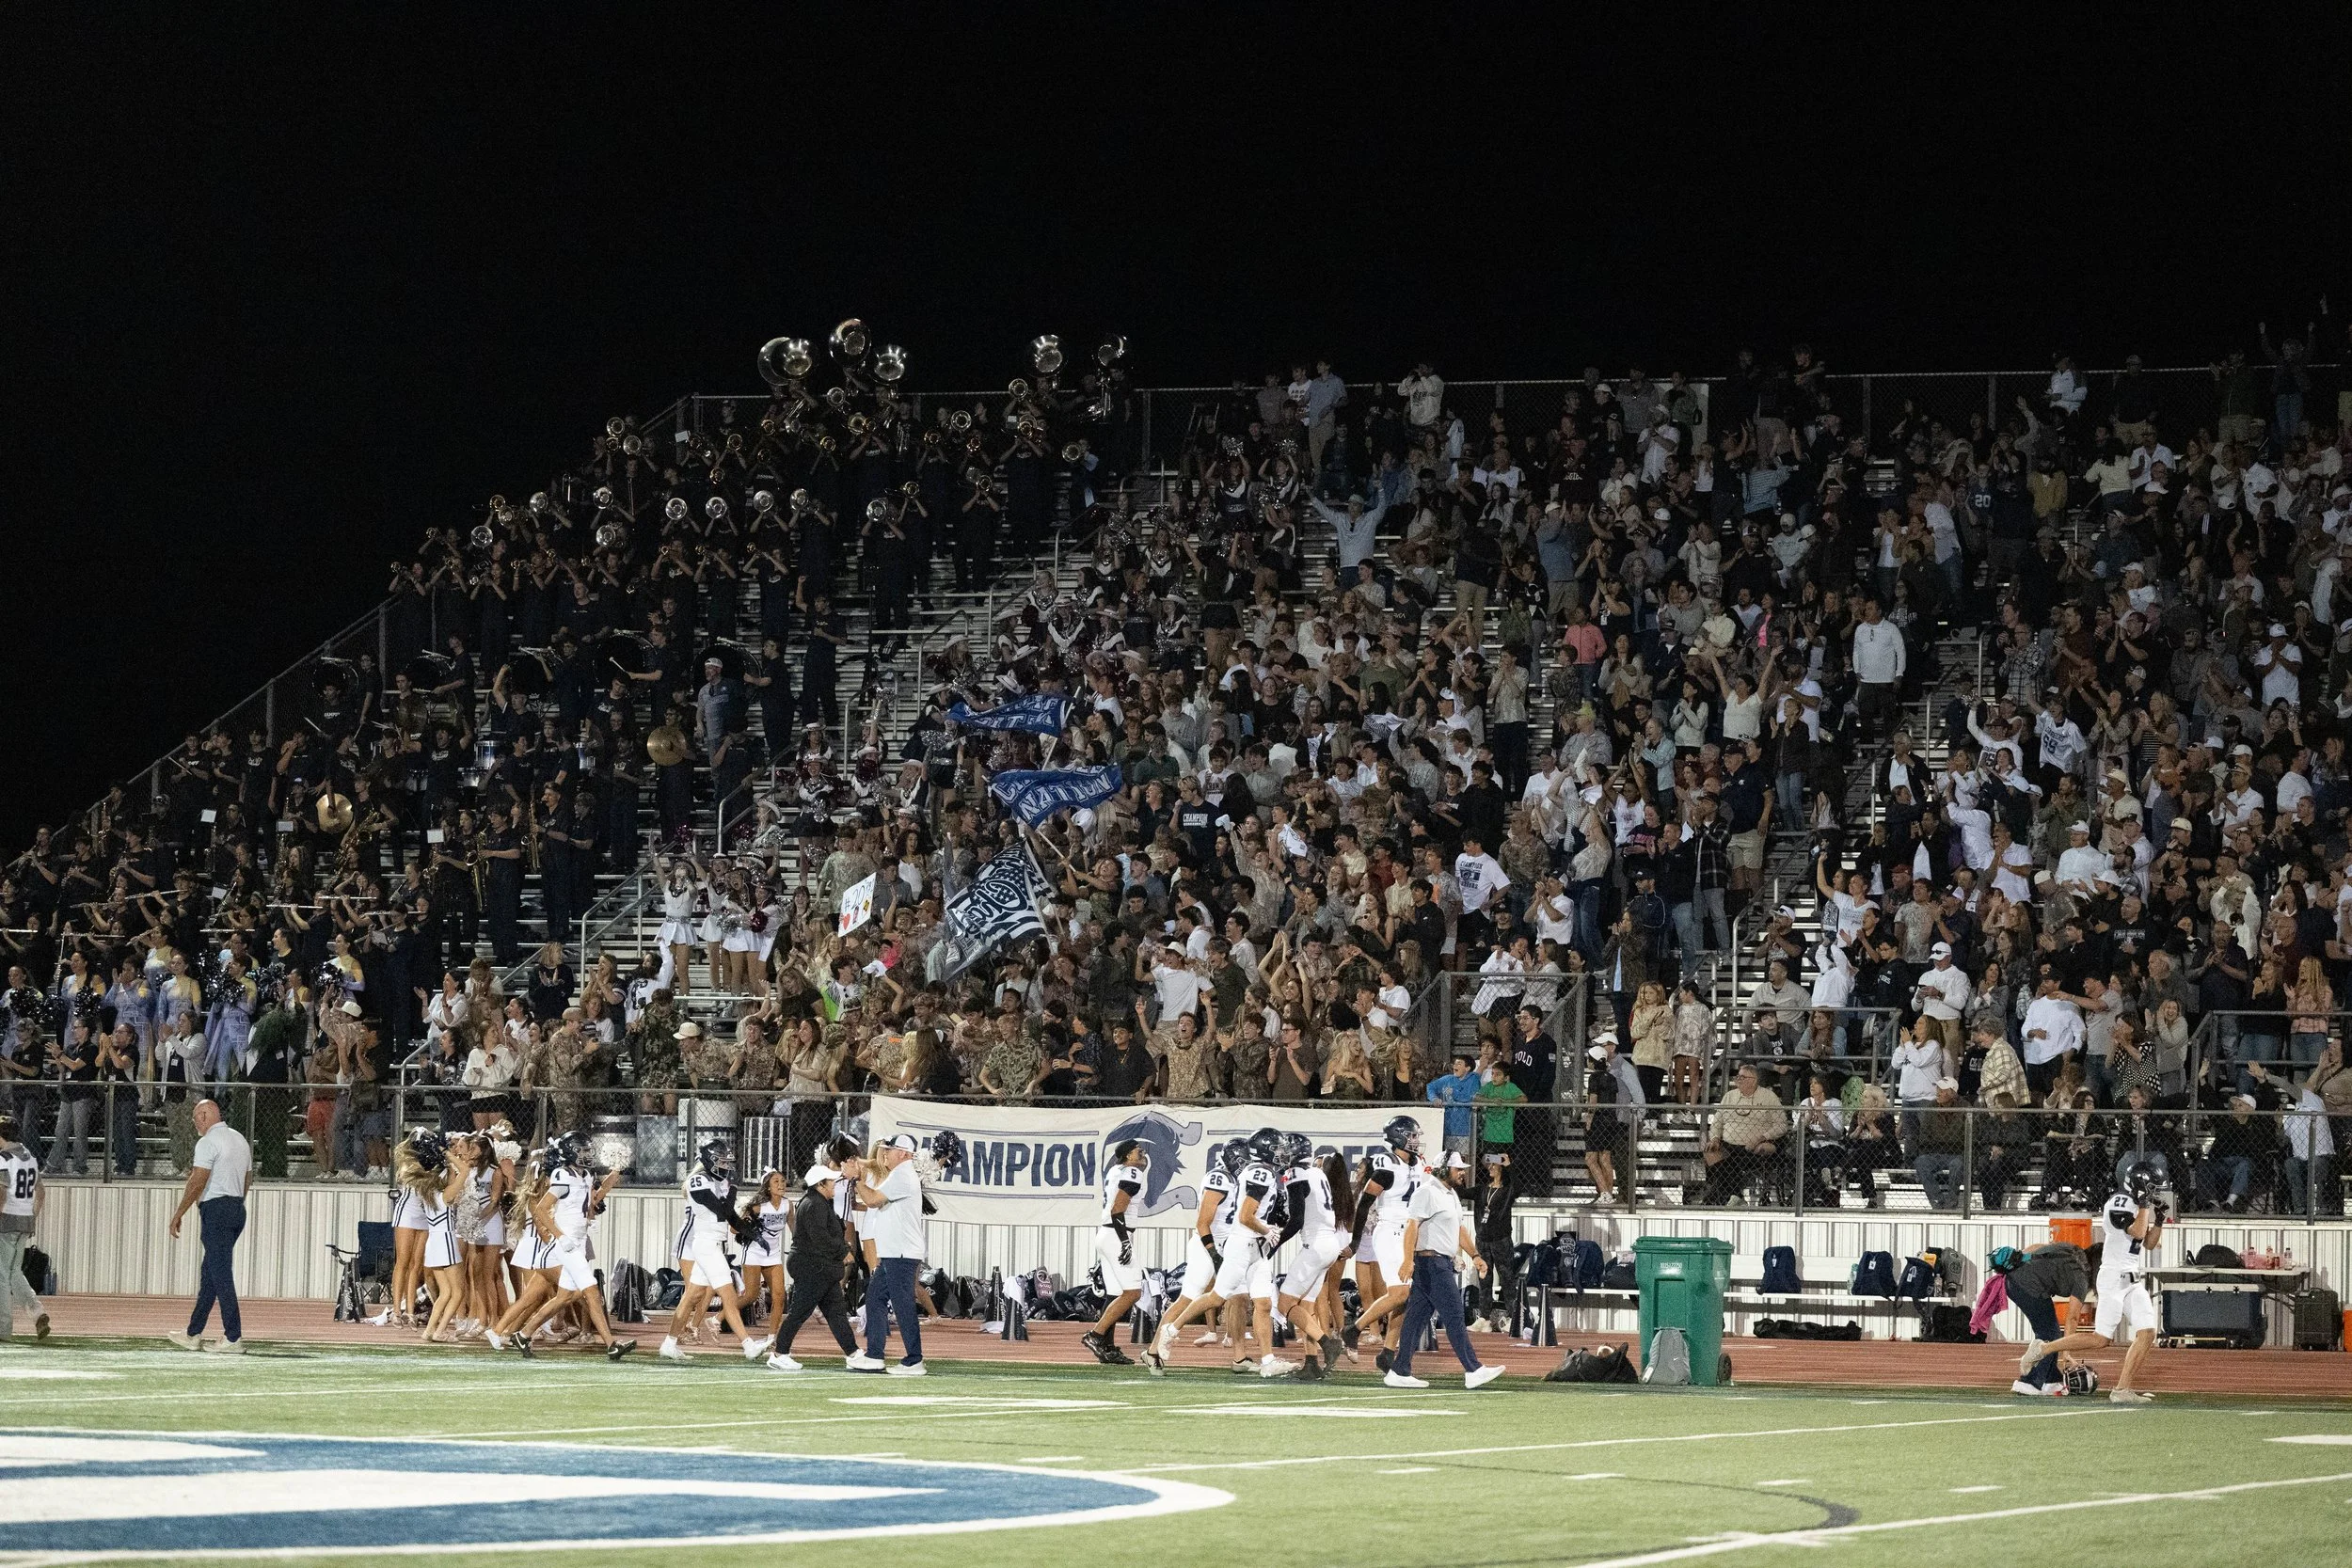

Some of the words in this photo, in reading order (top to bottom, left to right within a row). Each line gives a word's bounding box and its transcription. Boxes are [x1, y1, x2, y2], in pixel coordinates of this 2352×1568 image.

[1975, 494, 1991, 508] 20
[1019, 771, 1115, 824] NATION
[906, 1134, 1095, 1186] AMPION
[1375, 1156, 1385, 1167] 41
[555, 1171, 561, 1180] 4
[1130, 1169, 1136, 1179] 5
[1209, 1174, 1223, 1186] 26
[1252, 1169, 1267, 1182] 23
[15, 1167, 36, 1198] 82
[690, 1177, 703, 1188] 25
[2114, 1196, 2128, 1208] 27
